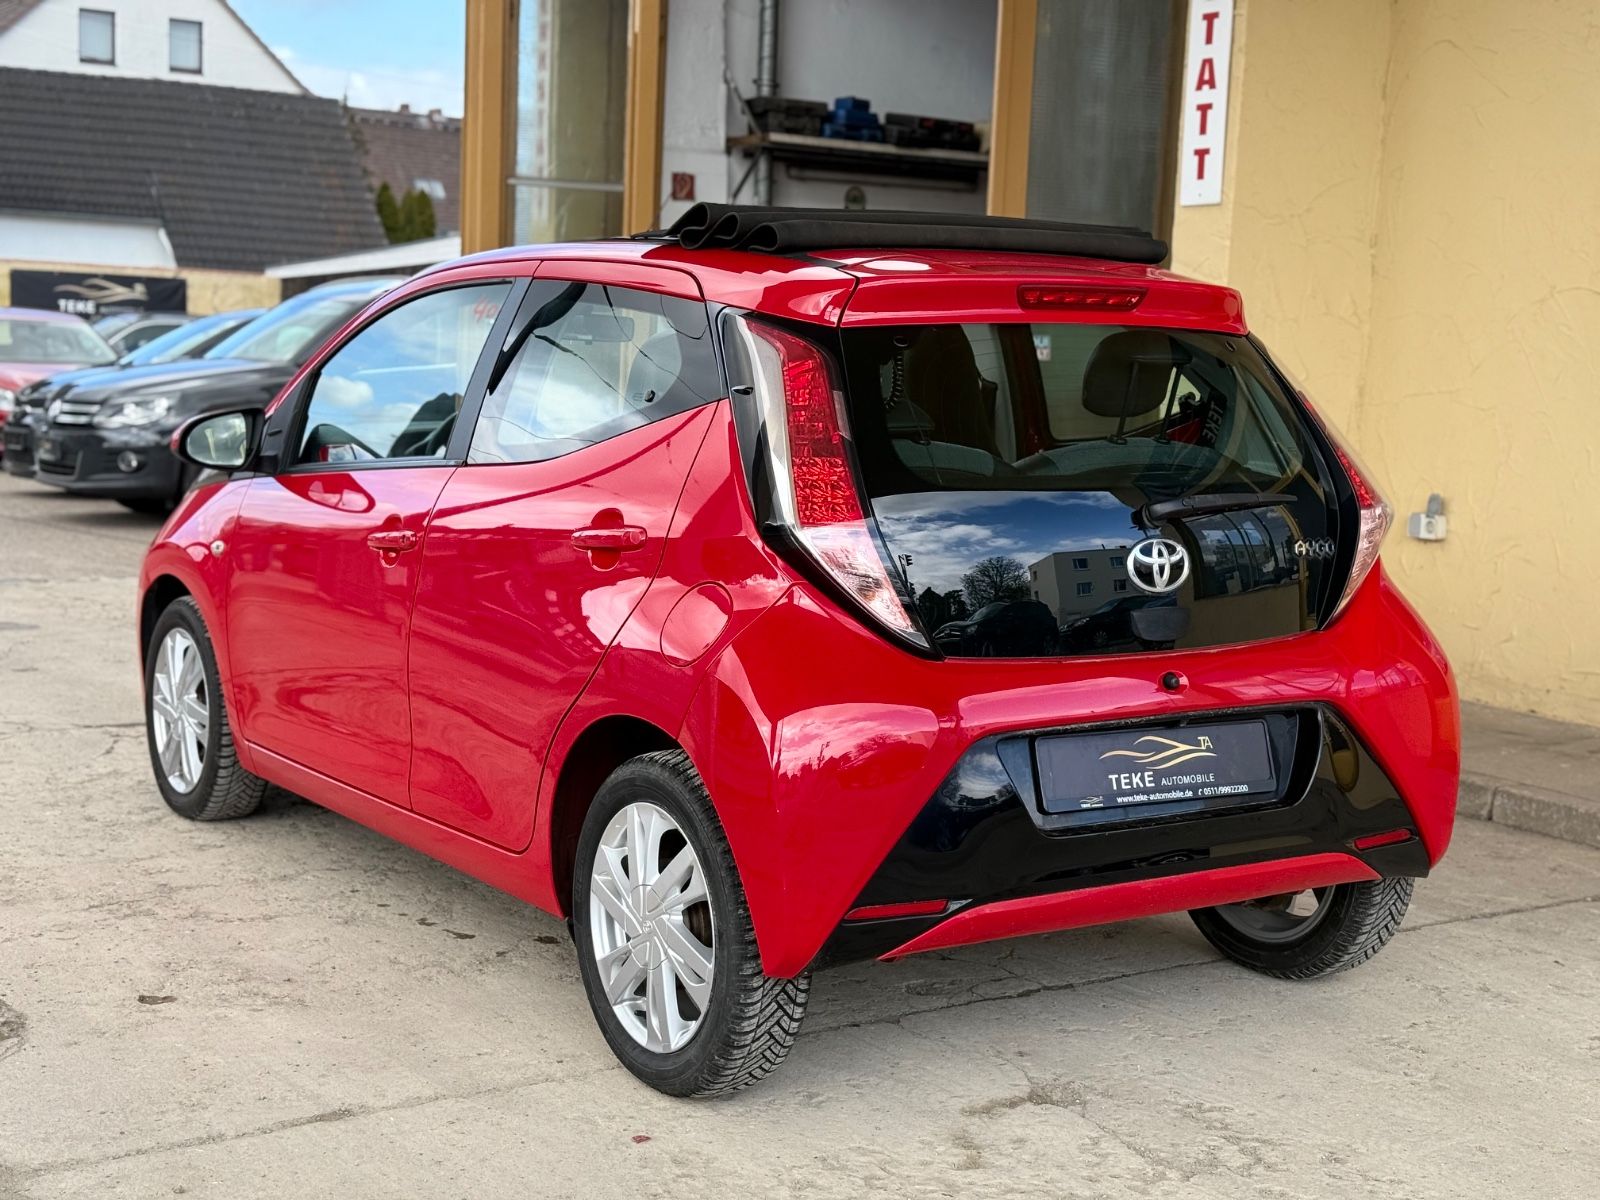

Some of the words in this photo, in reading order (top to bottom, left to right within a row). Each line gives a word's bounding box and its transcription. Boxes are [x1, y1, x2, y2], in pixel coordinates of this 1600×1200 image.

[1193, 0, 1220, 181] TATT
[57, 298, 97, 314] TEKE
[1294, 539, 1335, 560] AYGO
[1108, 772, 1155, 790] TEKE
[1161, 773, 1215, 786] AUTOMOBILE
[1117, 790, 1193, 803] www.teke-automobile.de
